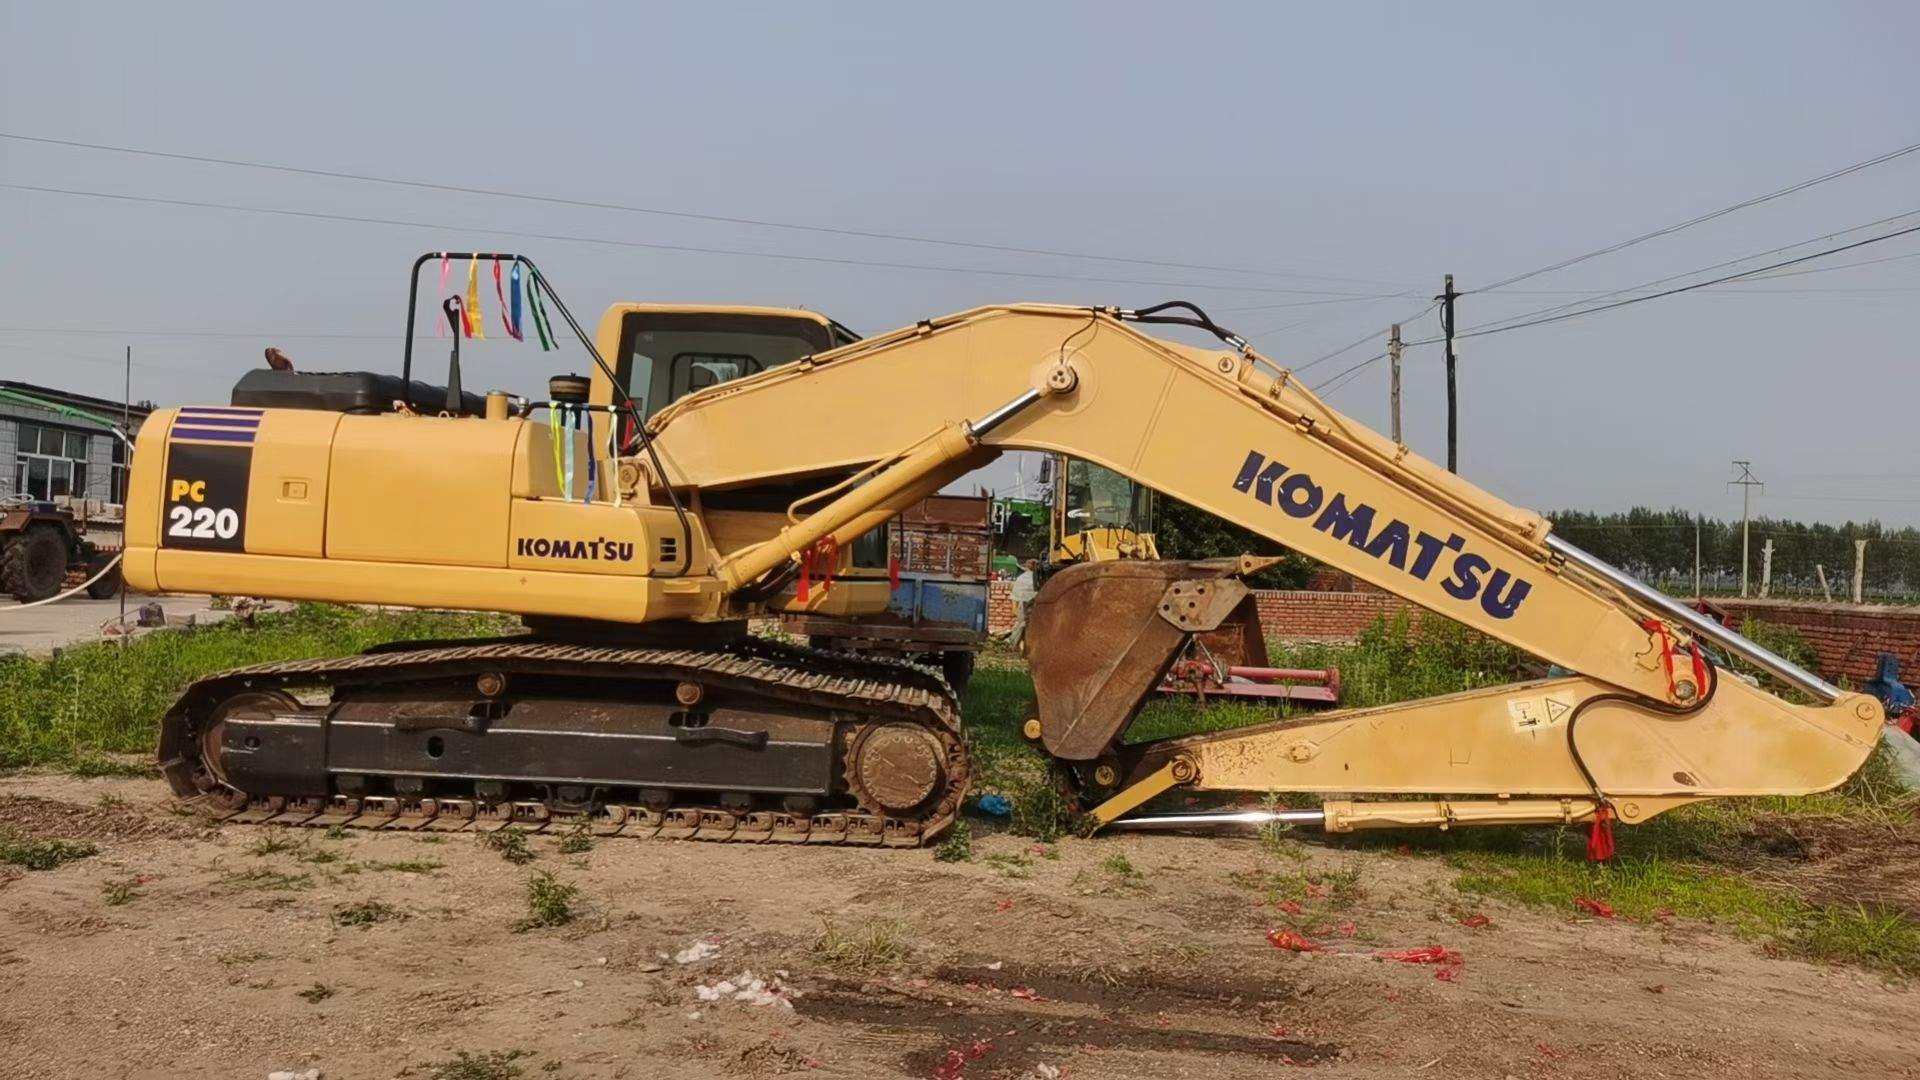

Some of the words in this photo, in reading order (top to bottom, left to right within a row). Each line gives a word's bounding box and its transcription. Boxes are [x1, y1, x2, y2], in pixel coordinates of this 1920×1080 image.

[171, 479, 206, 502] PC
[168, 505, 239, 539] 220
[1232, 450, 1533, 619] KOMATSU
[517, 536, 634, 562] KOMATSU
